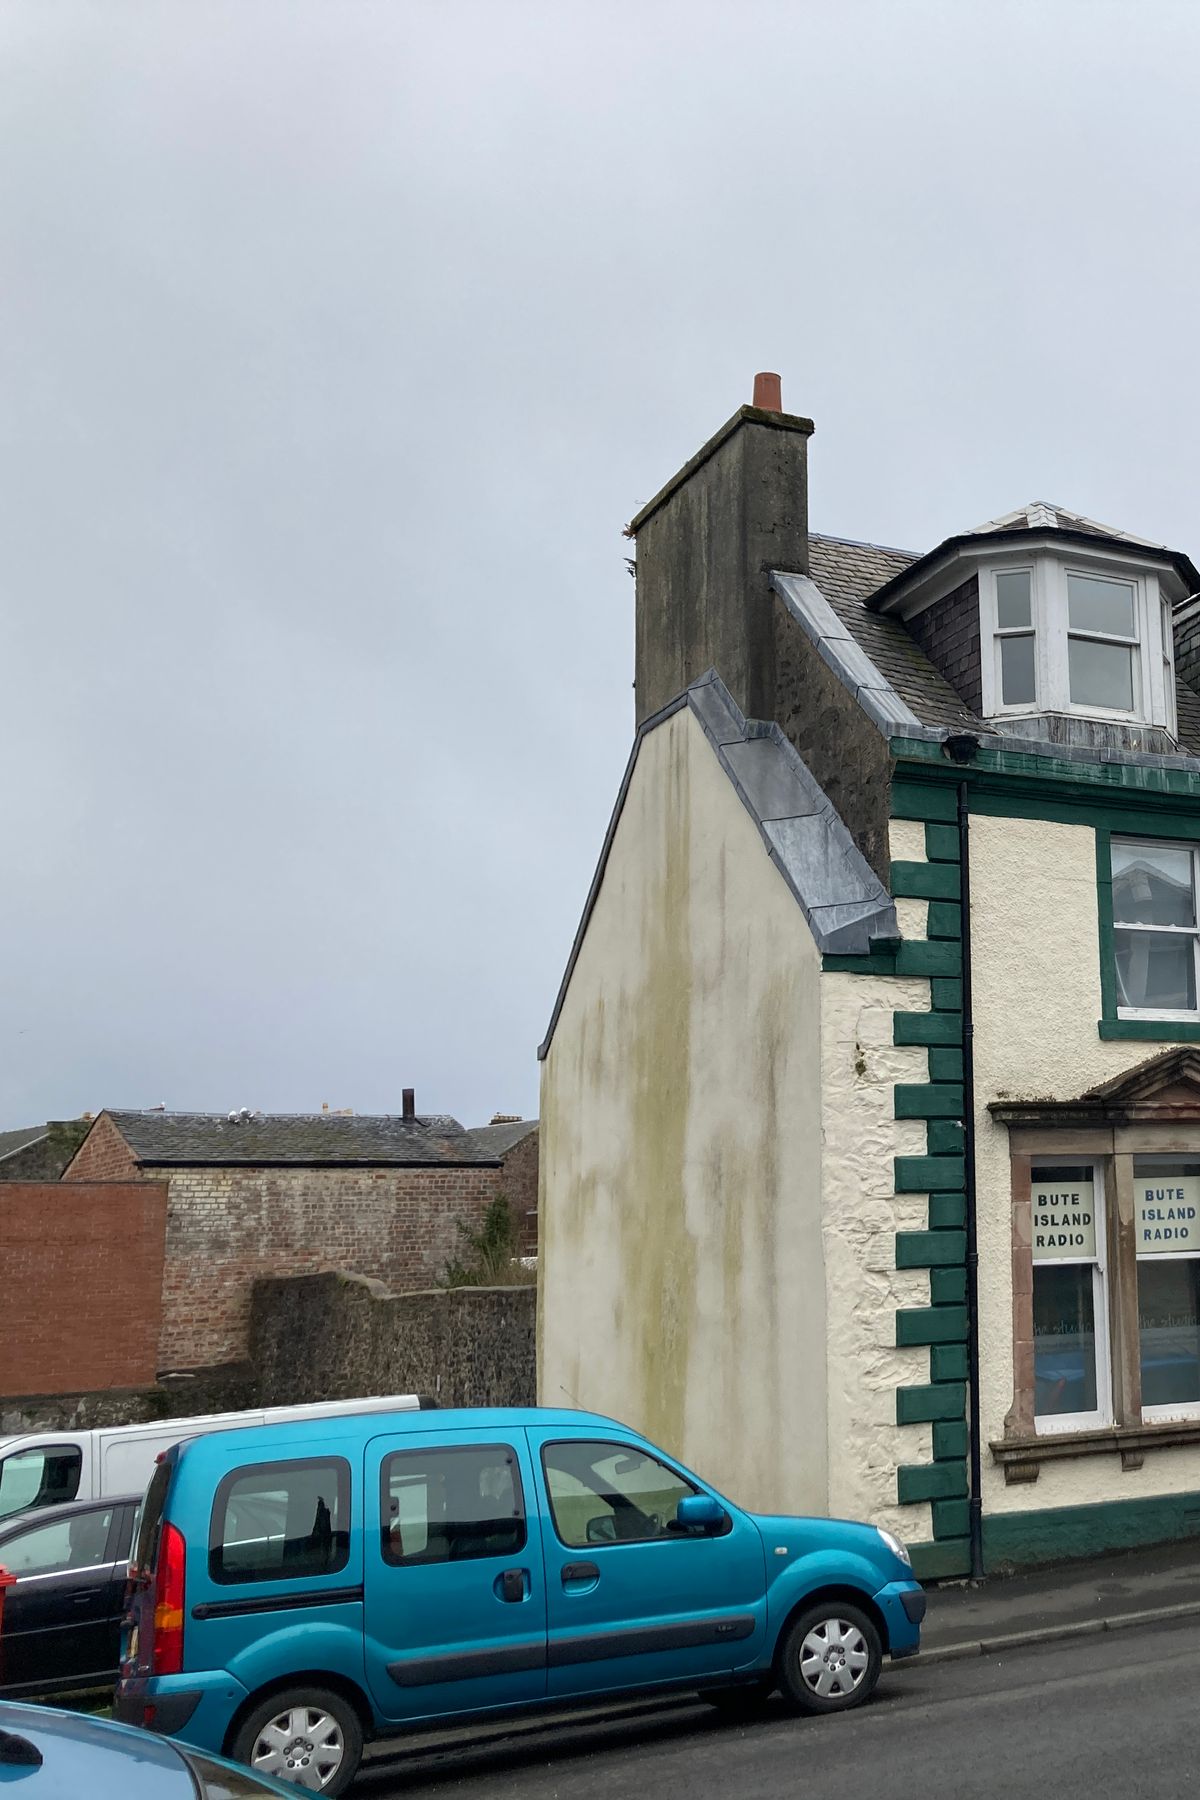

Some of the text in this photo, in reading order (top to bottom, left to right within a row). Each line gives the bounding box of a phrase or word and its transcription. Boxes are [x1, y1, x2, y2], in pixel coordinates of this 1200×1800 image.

[1038, 1193, 1080, 1206] BUTE
[1145, 1188, 1184, 1201] BUTE
[1034, 1213, 1091, 1226] ISLAND
[1142, 1207, 1196, 1220] ISLAND
[1036, 1233, 1084, 1247] RADIO
[1144, 1227, 1189, 1240] RADIO
